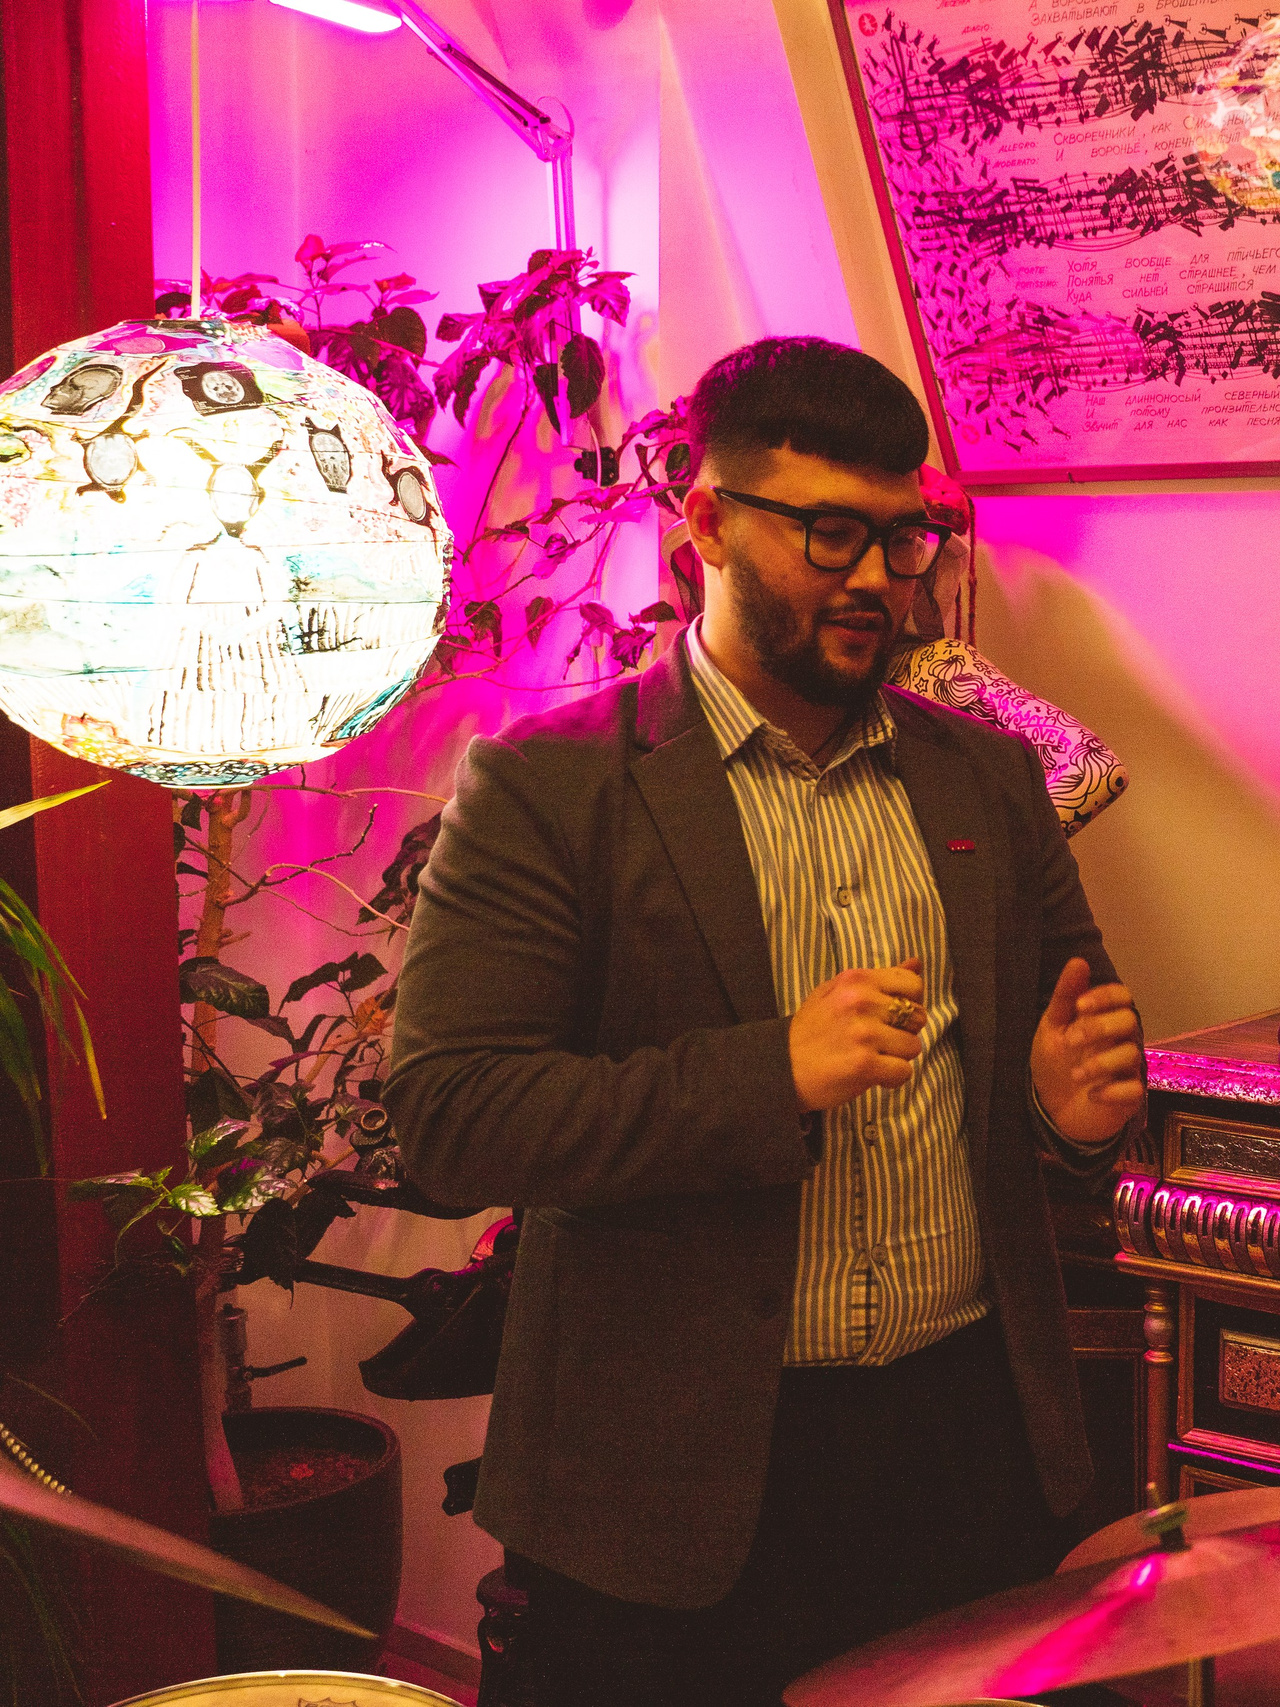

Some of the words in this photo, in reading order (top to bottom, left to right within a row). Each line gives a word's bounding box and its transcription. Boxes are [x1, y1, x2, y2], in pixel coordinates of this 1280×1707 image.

[1136, 2, 1145, 14] В
[1151, 122, 1171, 135] КАК
[1055, 148, 1065, 161] И
[1123, 256, 1172, 269] ВООБЩЕ
[1189, 253, 1210, 266] ДЛЯ
[1139, 267, 1160, 283] НЕТ
[1252, 264, 1277, 276] ЧЕМ
[1121, 282, 1168, 299] СИЛЬНЕЙ
[1223, 384, 1280, 401] СЕВЕРНЫЙ
[1133, 420, 1155, 431] ДЛЯ
[1166, 419, 1189, 429] НАС
[1207, 418, 1229, 428] КАК
[1246, 416, 1280, 427] ПЕСНЯ
